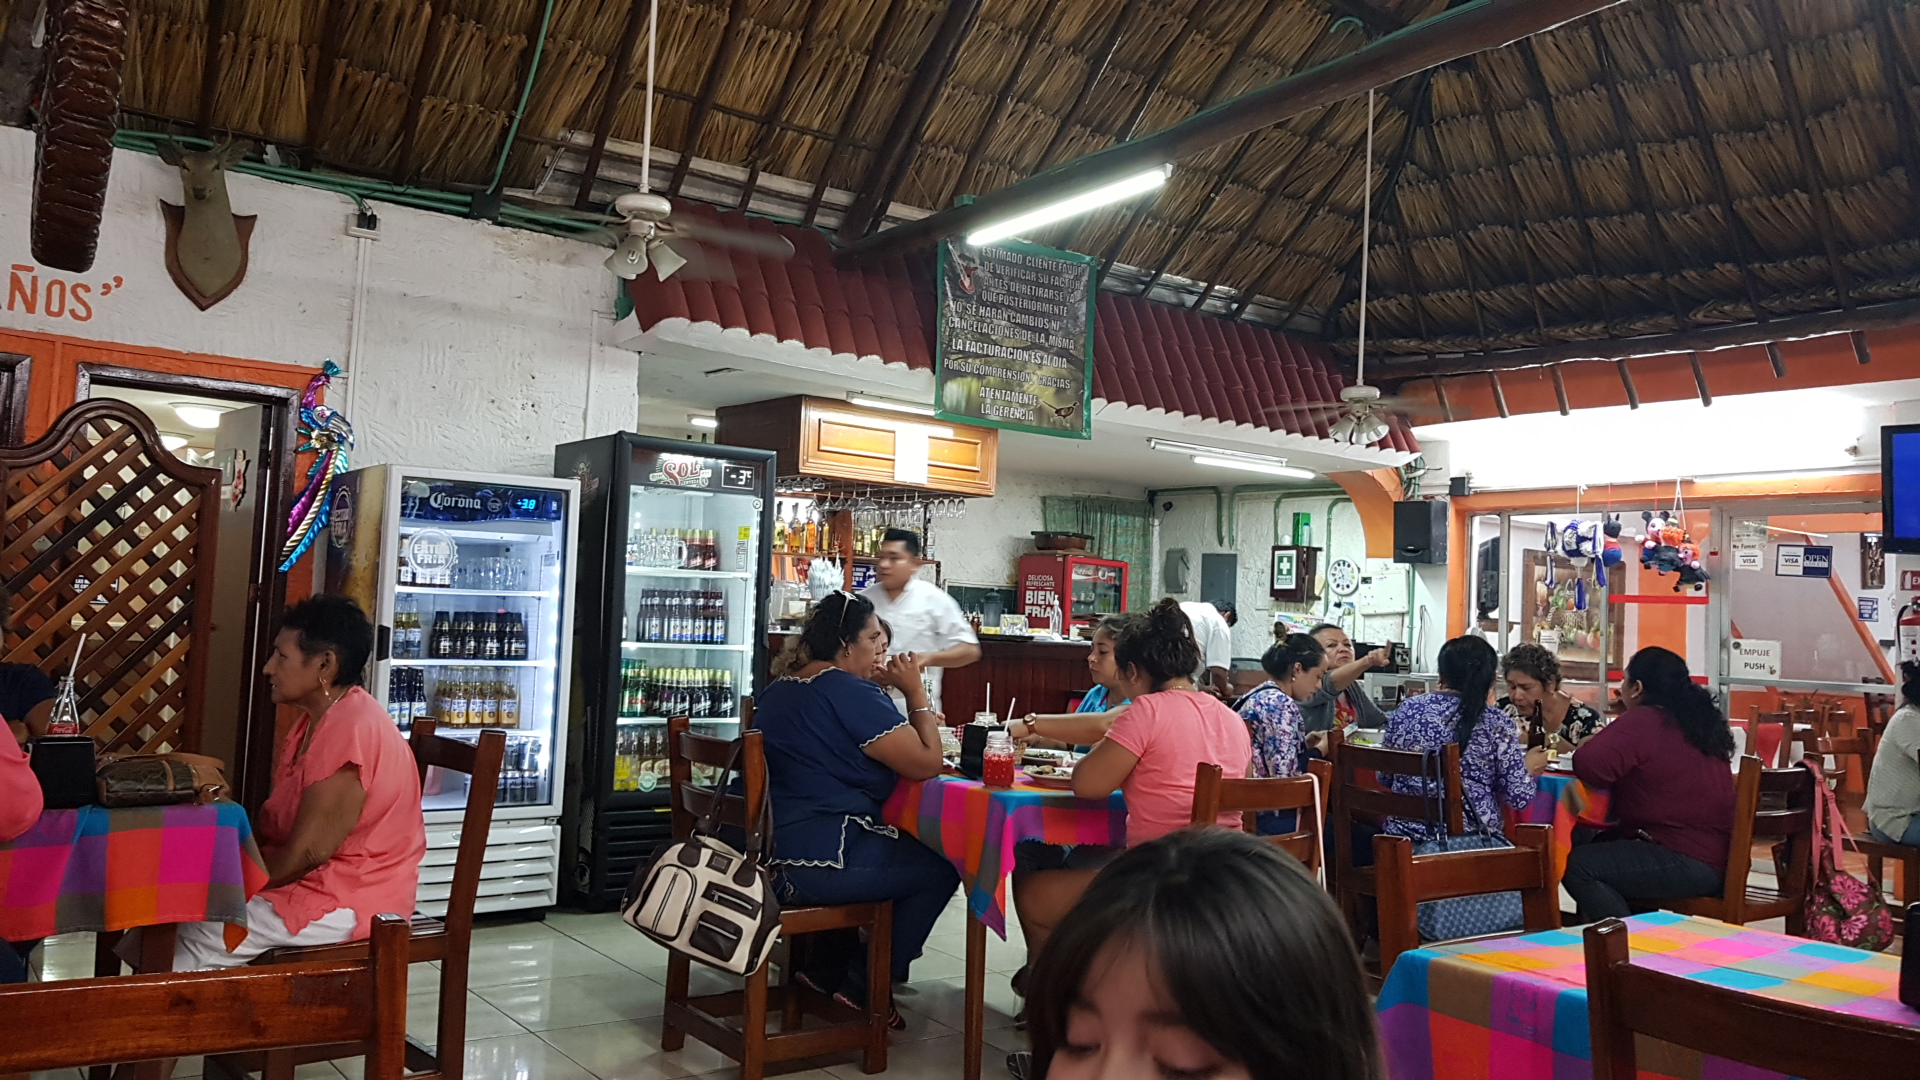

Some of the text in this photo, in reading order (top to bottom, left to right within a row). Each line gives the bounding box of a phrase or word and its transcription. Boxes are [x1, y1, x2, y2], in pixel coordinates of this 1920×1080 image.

[982, 247, 1083, 276] ESTIMADO CLIENTE FAVOR
[984, 262, 1084, 291] DE VERIFICAR SU FACTURA
[984, 276, 1075, 303] ANTES DE RETIRARSE YA
[950, 301, 1060, 330] NO SE HARAN CAMBIOS NI
[982, 290, 1068, 316] QUE POSTERIORMENTE
[948, 316, 1020, 339] CANCELACIONES
[1022, 330, 1032, 341] DE
[1036, 332, 1045, 344] LA
[952, 338, 963, 350] LA
[966, 340, 1028, 361] FACTURACION
[1031, 352, 1041, 364] ES
[1052, 356, 1067, 369] DIA
[944, 358, 958, 368] POR
[960, 362, 970, 372] SU
[1038, 375, 1071, 389] GRACIAS
[980, 387, 1038, 406] ATENTAMENTE
[982, 403, 1034, 420] LA GERENCIA
[430, 492, 481, 510] Corona
[1804, 554, 1828, 562] OPEN
[1025, 590, 1054, 604] BIEN
[1744, 662, 1766, 670] PUSH
